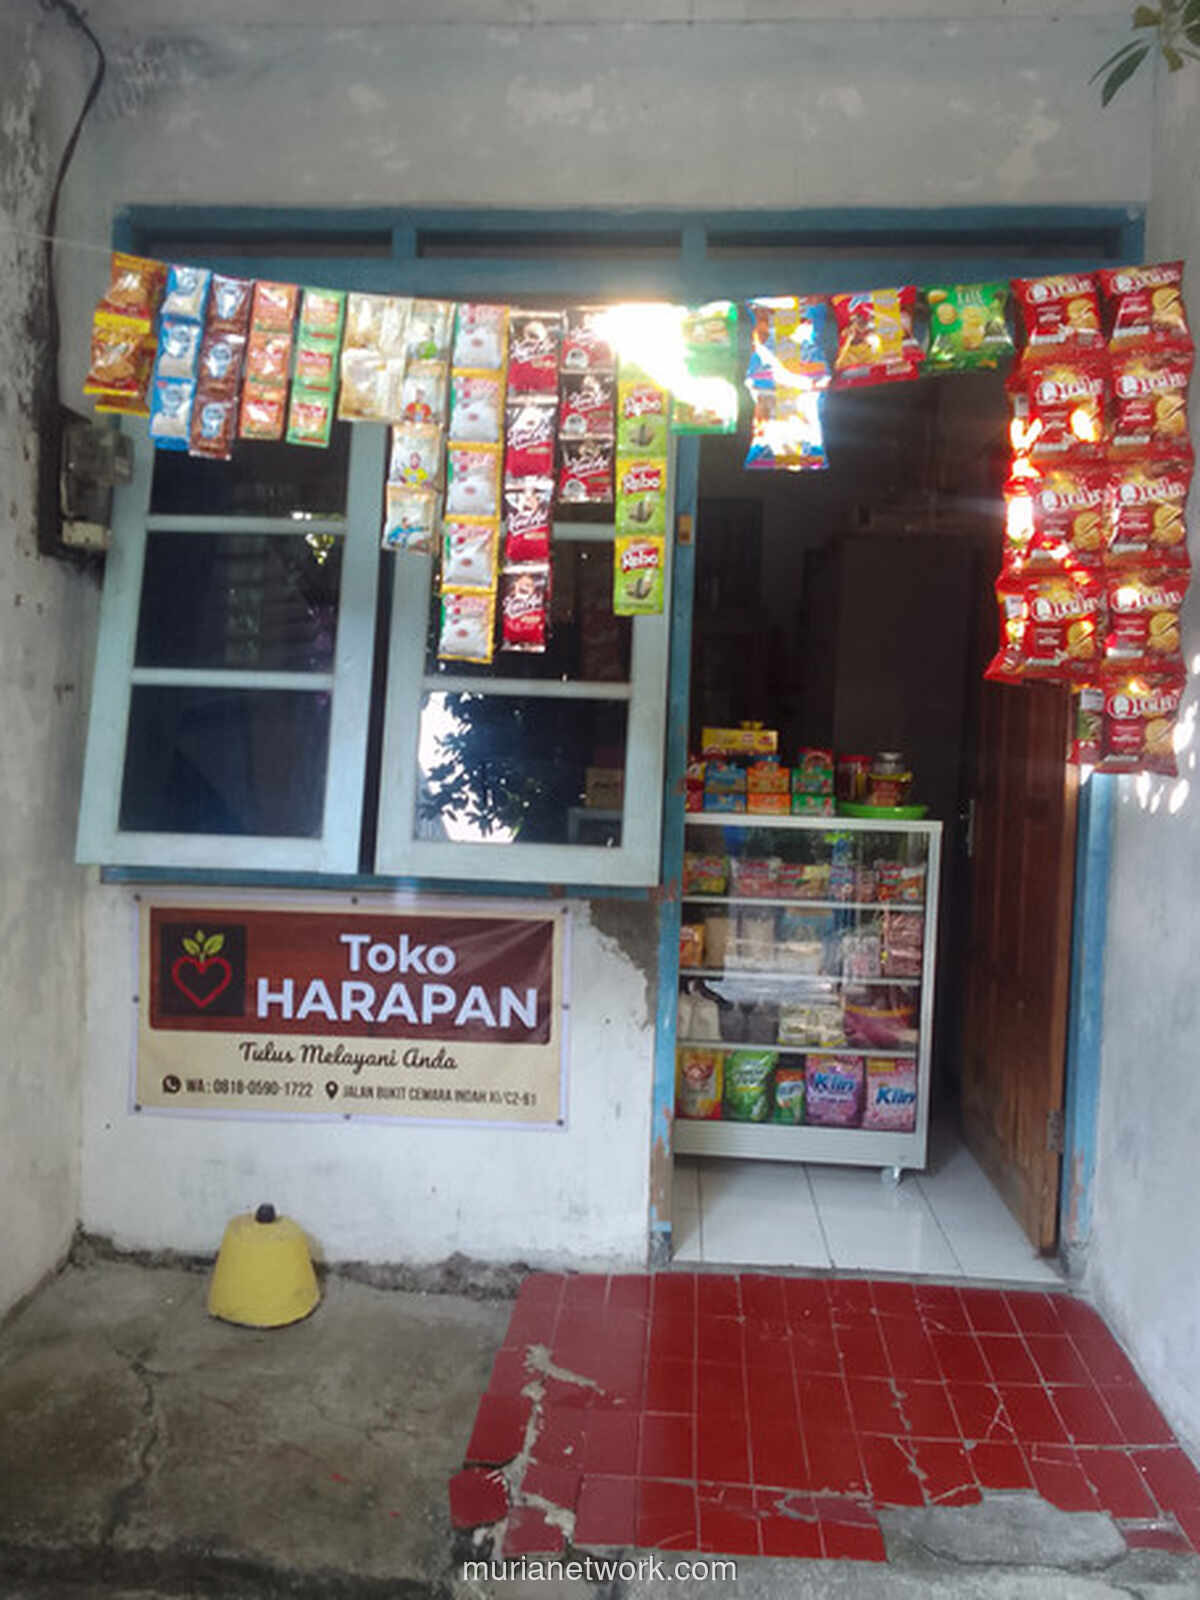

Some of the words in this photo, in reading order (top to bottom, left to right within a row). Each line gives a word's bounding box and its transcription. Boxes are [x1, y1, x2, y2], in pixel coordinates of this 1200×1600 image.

[339, 932, 456, 975] Toko
[256, 978, 538, 1028] HARAPAN
[239, 1041, 296, 1064] Tulus
[299, 1043, 398, 1076] Melayani
[402, 1046, 459, 1070] Anda
[343, 1084, 374, 1099] JALAN
[376, 1085, 406, 1100] BUKIT
[408, 1086, 452, 1101] CEMARA
[814, 1071, 855, 1093] Klin
[875, 1086, 917, 1106] Klin
